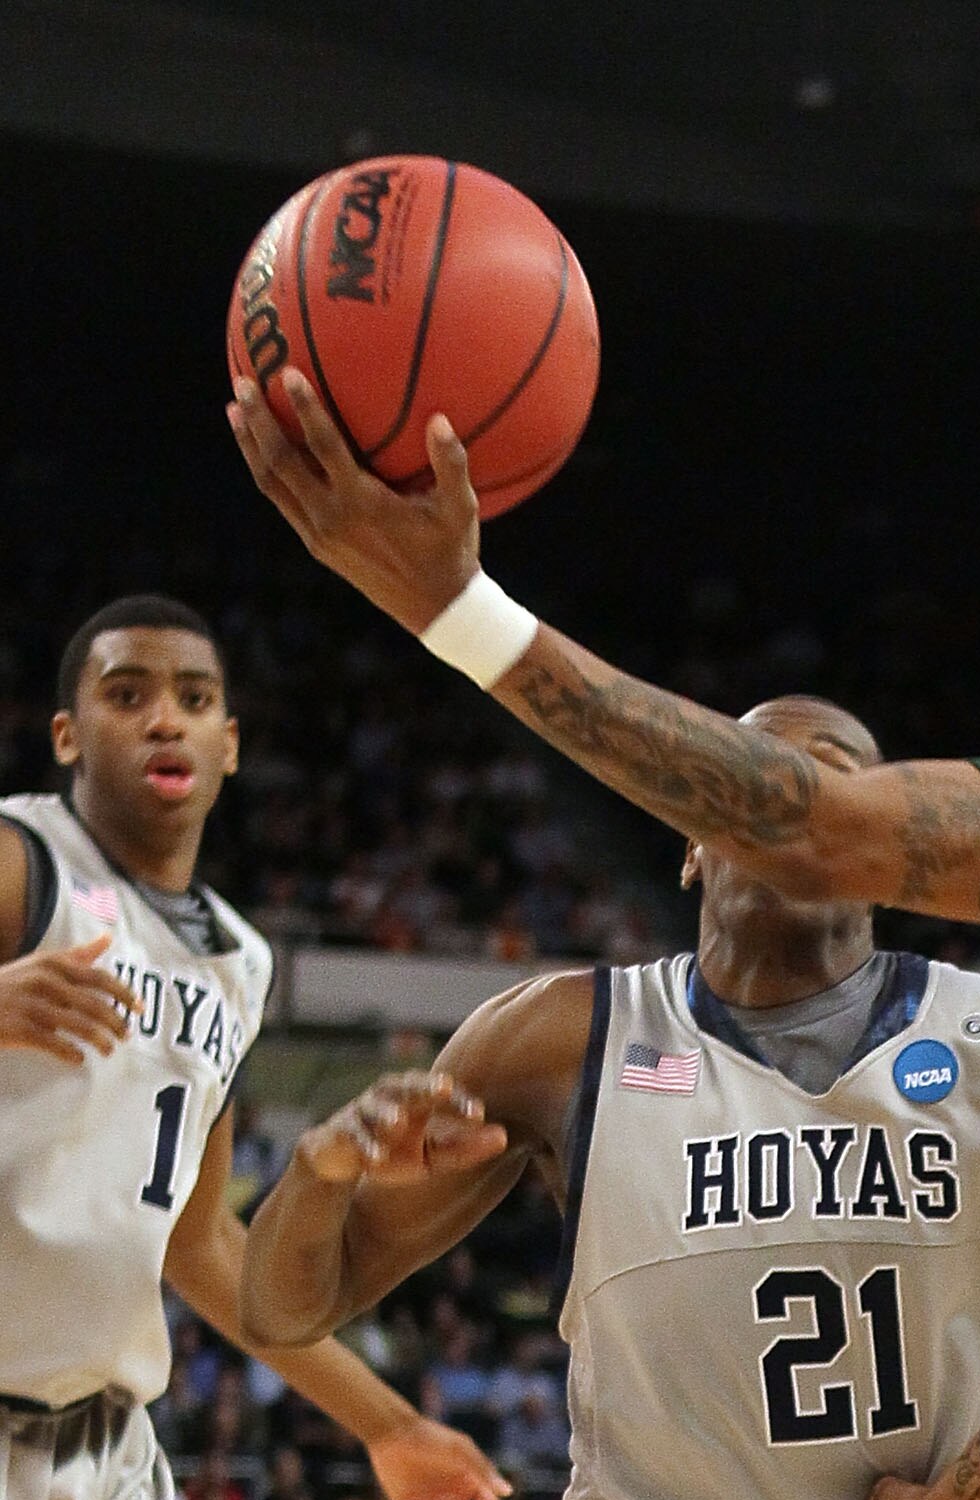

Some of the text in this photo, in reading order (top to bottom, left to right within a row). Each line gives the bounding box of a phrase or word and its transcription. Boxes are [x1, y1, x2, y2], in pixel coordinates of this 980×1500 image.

[326, 169, 392, 303] NCAA
[903, 1066, 952, 1090] NCAA
[139, 1082, 191, 1211] 1
[682, 1124, 960, 1235] HOYAS
[752, 1265, 920, 1446] 21
